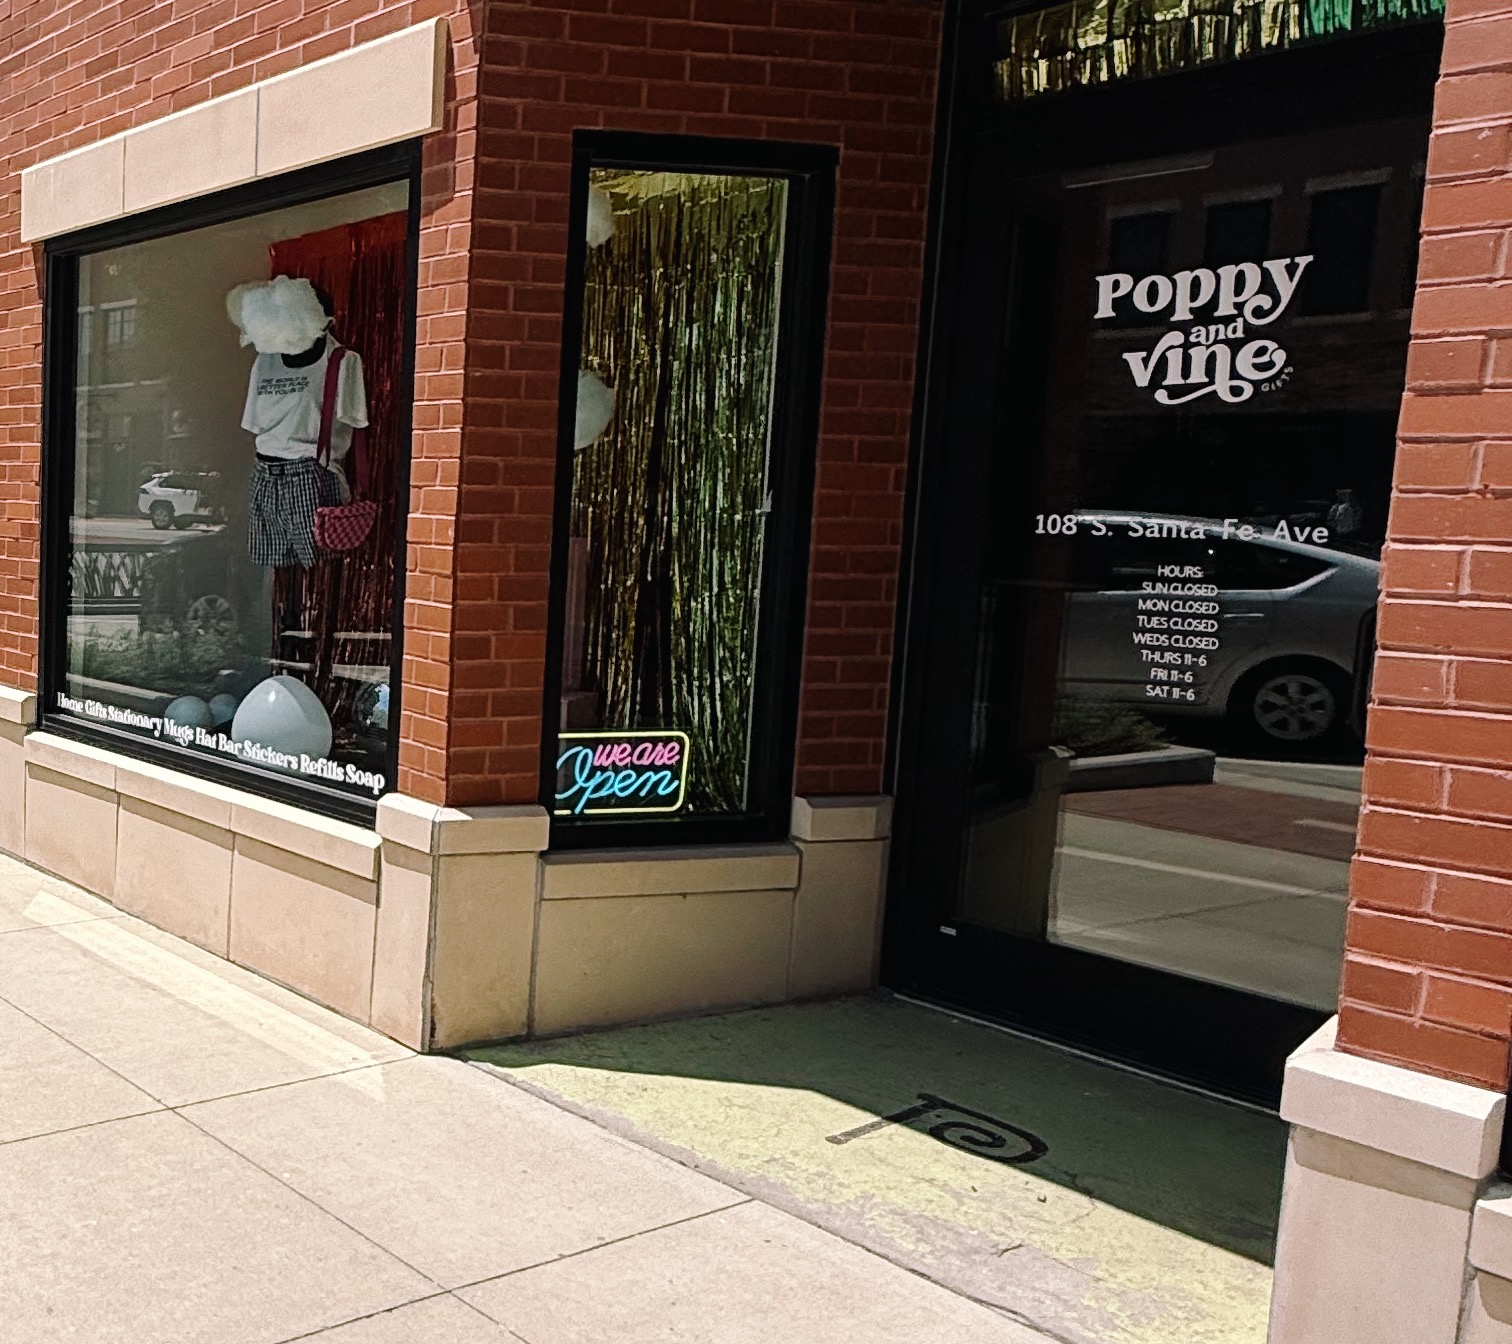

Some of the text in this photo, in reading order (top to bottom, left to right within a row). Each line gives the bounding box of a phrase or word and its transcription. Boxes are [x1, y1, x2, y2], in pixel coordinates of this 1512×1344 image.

[1093, 255, 1314, 325] Poppy
[1189, 317, 1244, 344] and
[1261, 366, 1293, 392] GIFTS
[1035, 514, 1077, 535] 108
[1091, 516, 1113, 537] S.
[1127, 518, 1206, 540] Santa
[1273, 519, 1329, 544] Ave
[1142, 582, 1218, 596] SUN CLOSED
[1138, 599, 1220, 614] MON CLOSED
[1137, 615, 1219, 633] TUES CLOSED
[1132, 632, 1219, 650] WEDS CLOSED
[1140, 650, 1207, 666] THURS 11-6
[1150, 668, 1193, 683] FRI 11-6
[1145, 685, 1195, 701] SAT 11-6
[57, 691, 385, 795] Home Gifts Stationary Mugs Hat Bar Stickers Refills Soap
[593, 741, 680, 767] we are
[555, 746, 679, 814] Open
